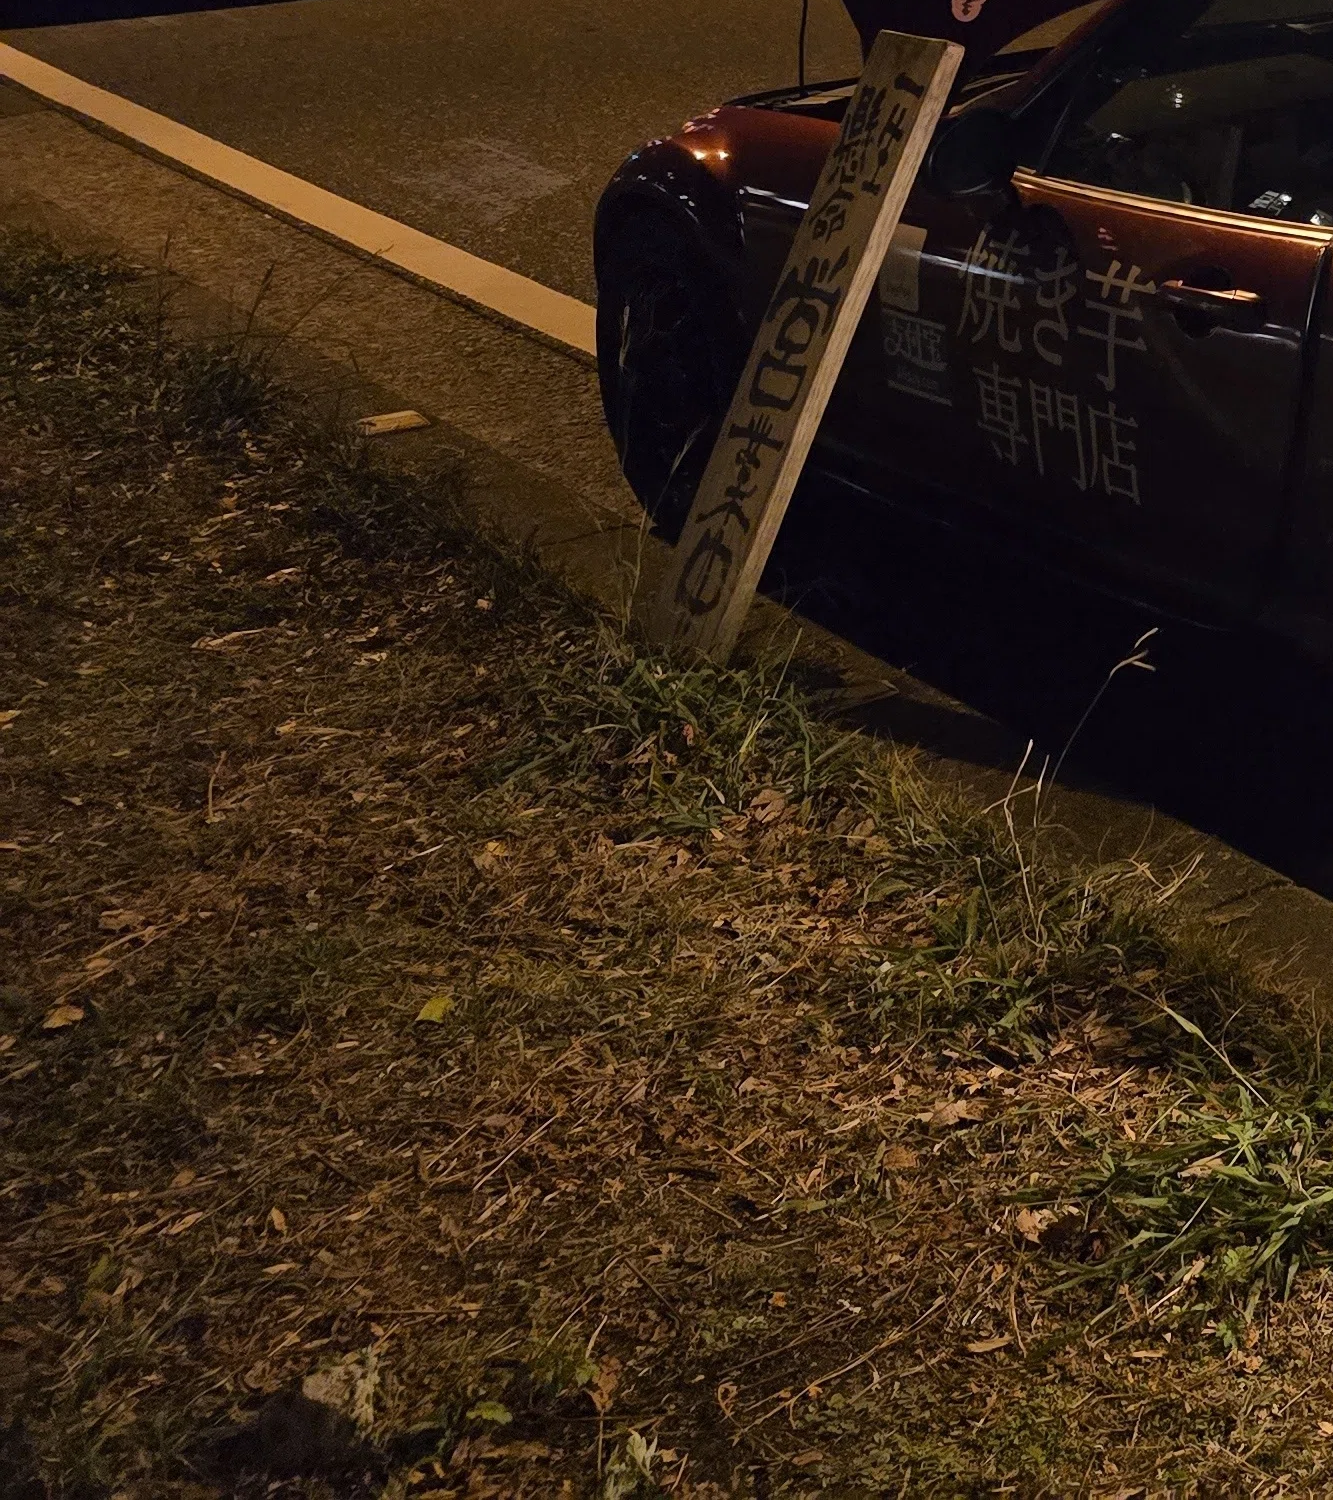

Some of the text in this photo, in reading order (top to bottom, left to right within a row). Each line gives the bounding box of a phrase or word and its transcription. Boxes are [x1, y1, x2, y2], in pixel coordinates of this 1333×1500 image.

[956, 223, 1156, 392] 焼き芋
[972, 362, 1142, 507] 専門店
